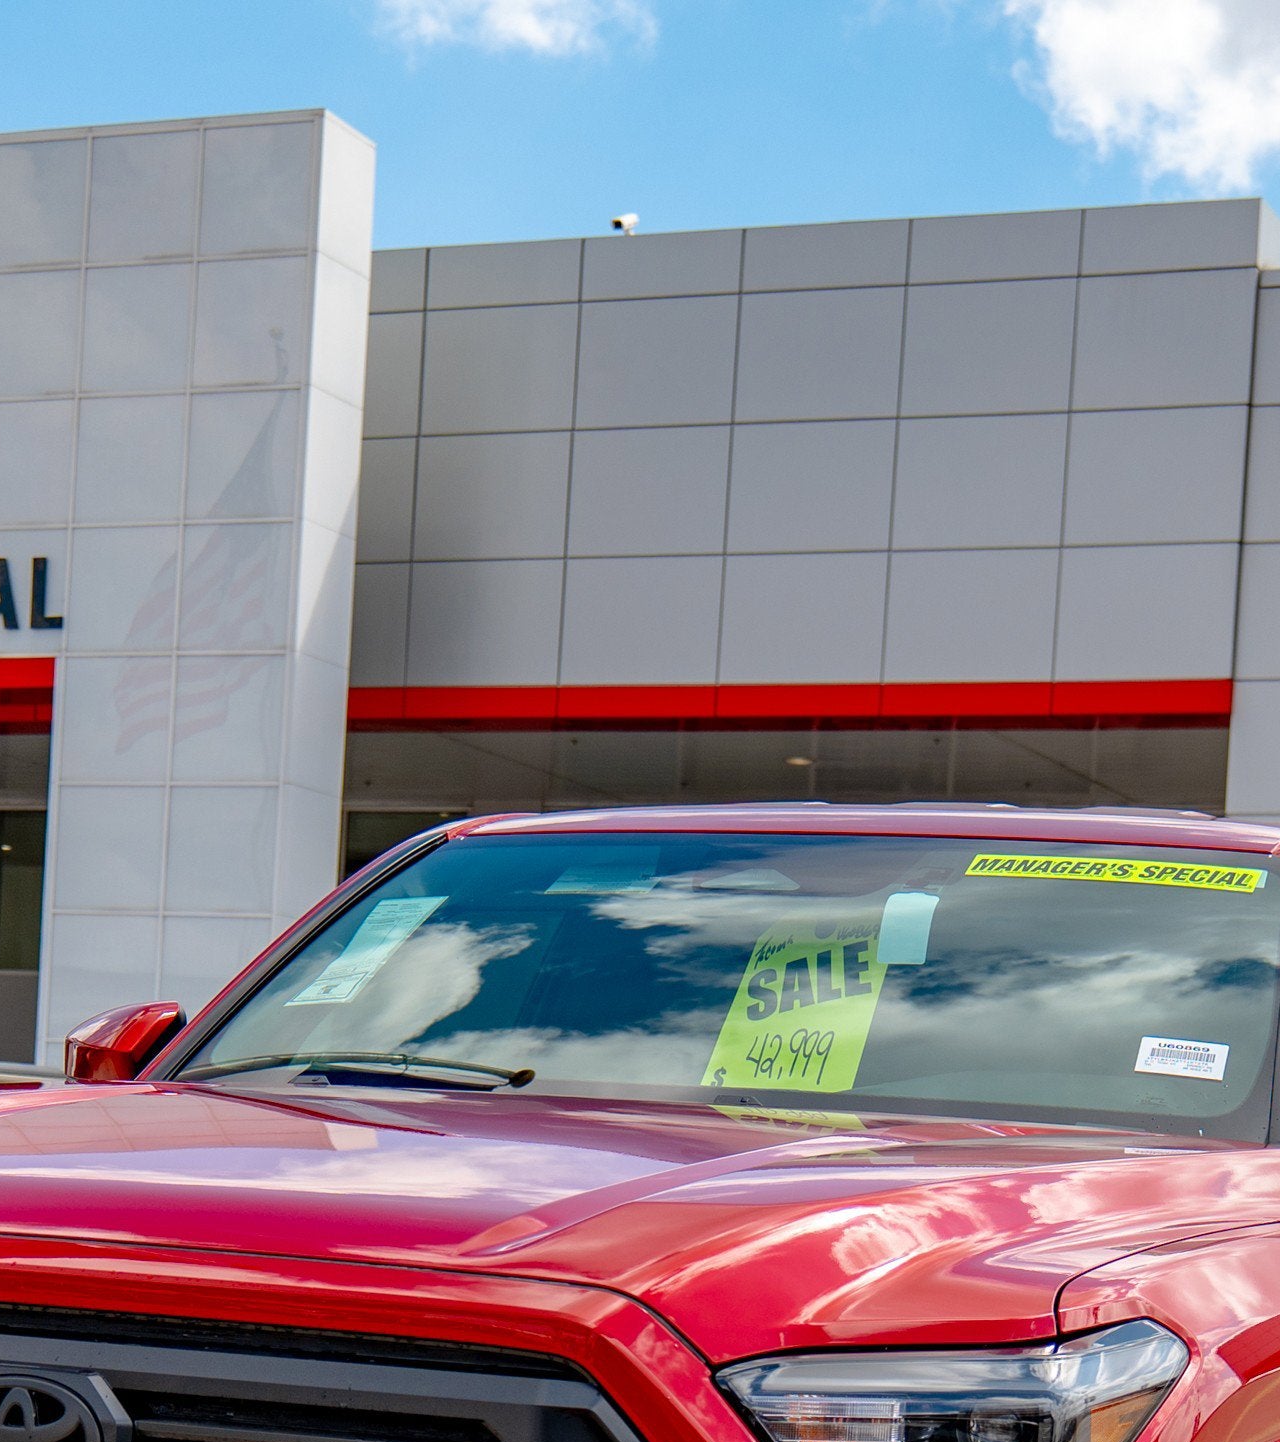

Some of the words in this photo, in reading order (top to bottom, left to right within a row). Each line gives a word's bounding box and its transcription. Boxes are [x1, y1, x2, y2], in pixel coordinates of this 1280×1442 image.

[970, 858, 1135, 878] MANAGER'S
[1138, 864, 1254, 887] SPECIAL
[746, 940, 872, 1022] SALE
[745, 1028, 835, 1086] 42,999
[1158, 1042, 1210, 1053] U60869
